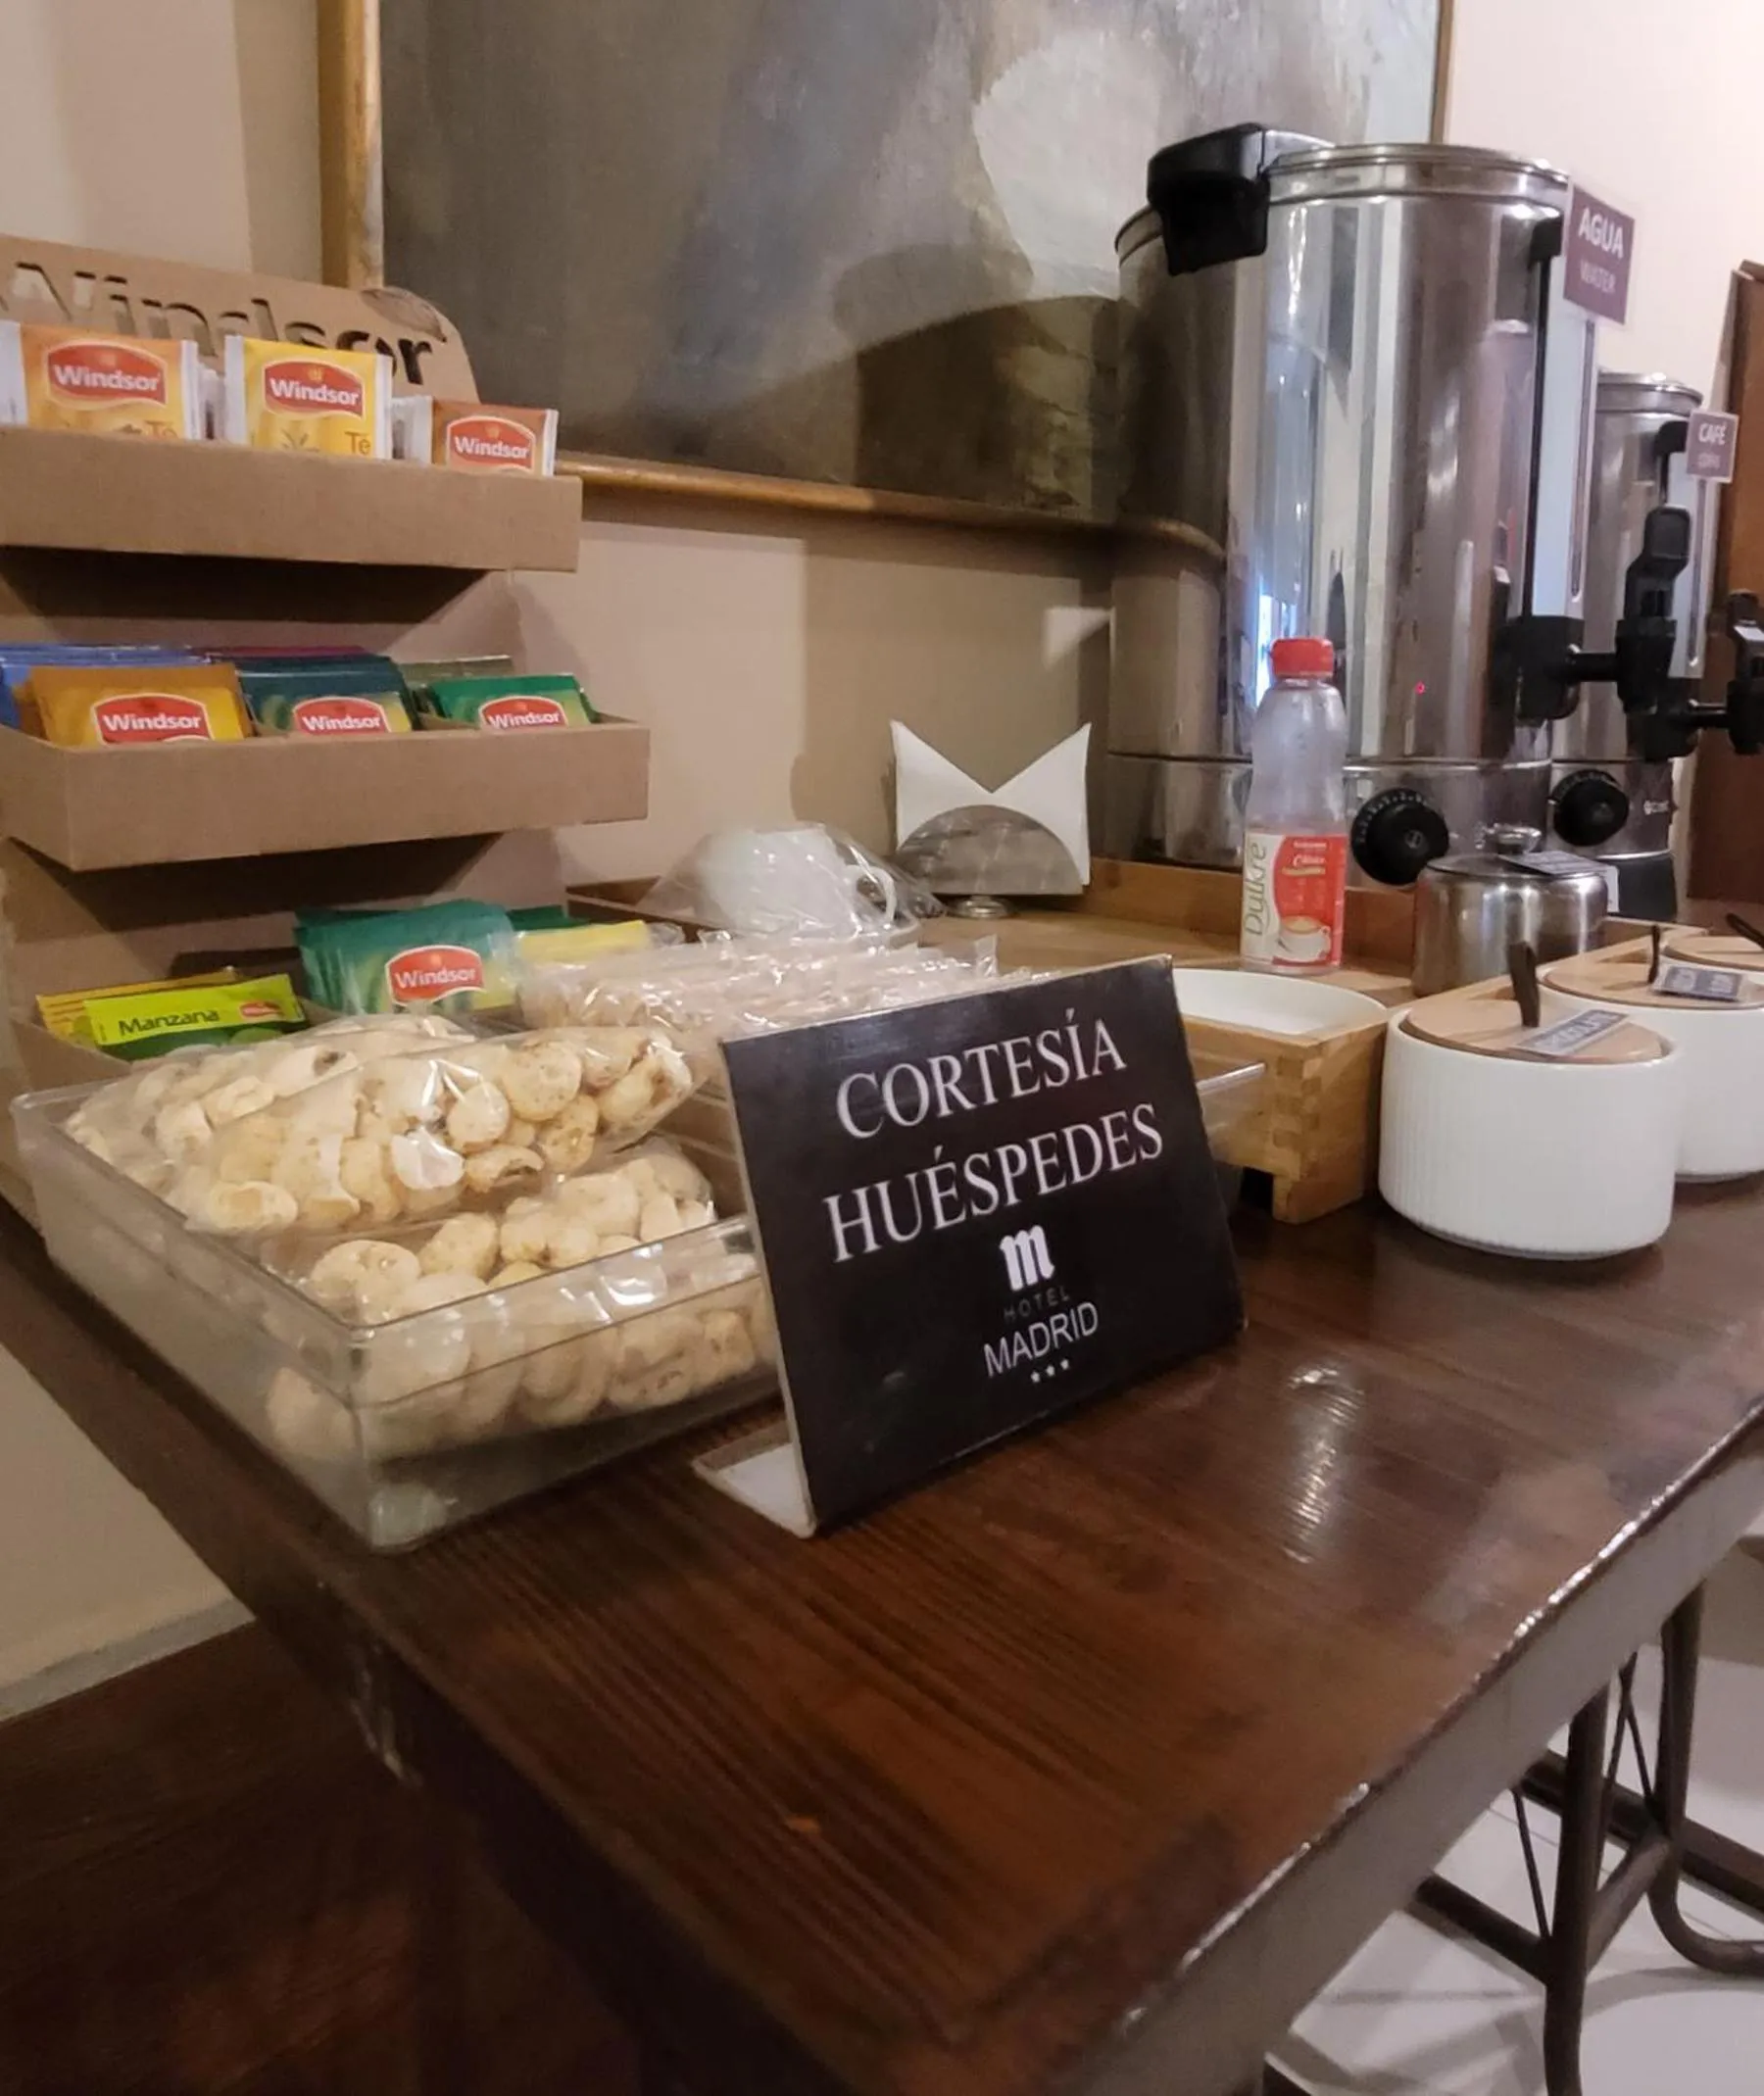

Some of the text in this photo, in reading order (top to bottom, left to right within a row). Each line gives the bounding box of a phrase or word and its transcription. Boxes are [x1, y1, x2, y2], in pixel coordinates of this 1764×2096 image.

[1578, 206, 1624, 259] AGUA
[1580, 259, 1617, 293] WATER
[53, 364, 161, 392] Windsor
[270, 378, 360, 407] Windsor
[454, 436, 530, 460] Windsor
[102, 712, 202, 732] Windsor
[301, 713, 381, 731] Windsor
[488, 711, 560, 730] Windsor
[394, 966, 476, 990] Windsor
[117, 1008, 220, 1037] Manzana
[836, 1007, 1128, 1140] CORTESÍA
[822, 1102, 1164, 1263] HUÉSPEDES
[1003, 1284, 1071, 1323] HOTEL
[982, 1300, 1100, 1378] MADRID
